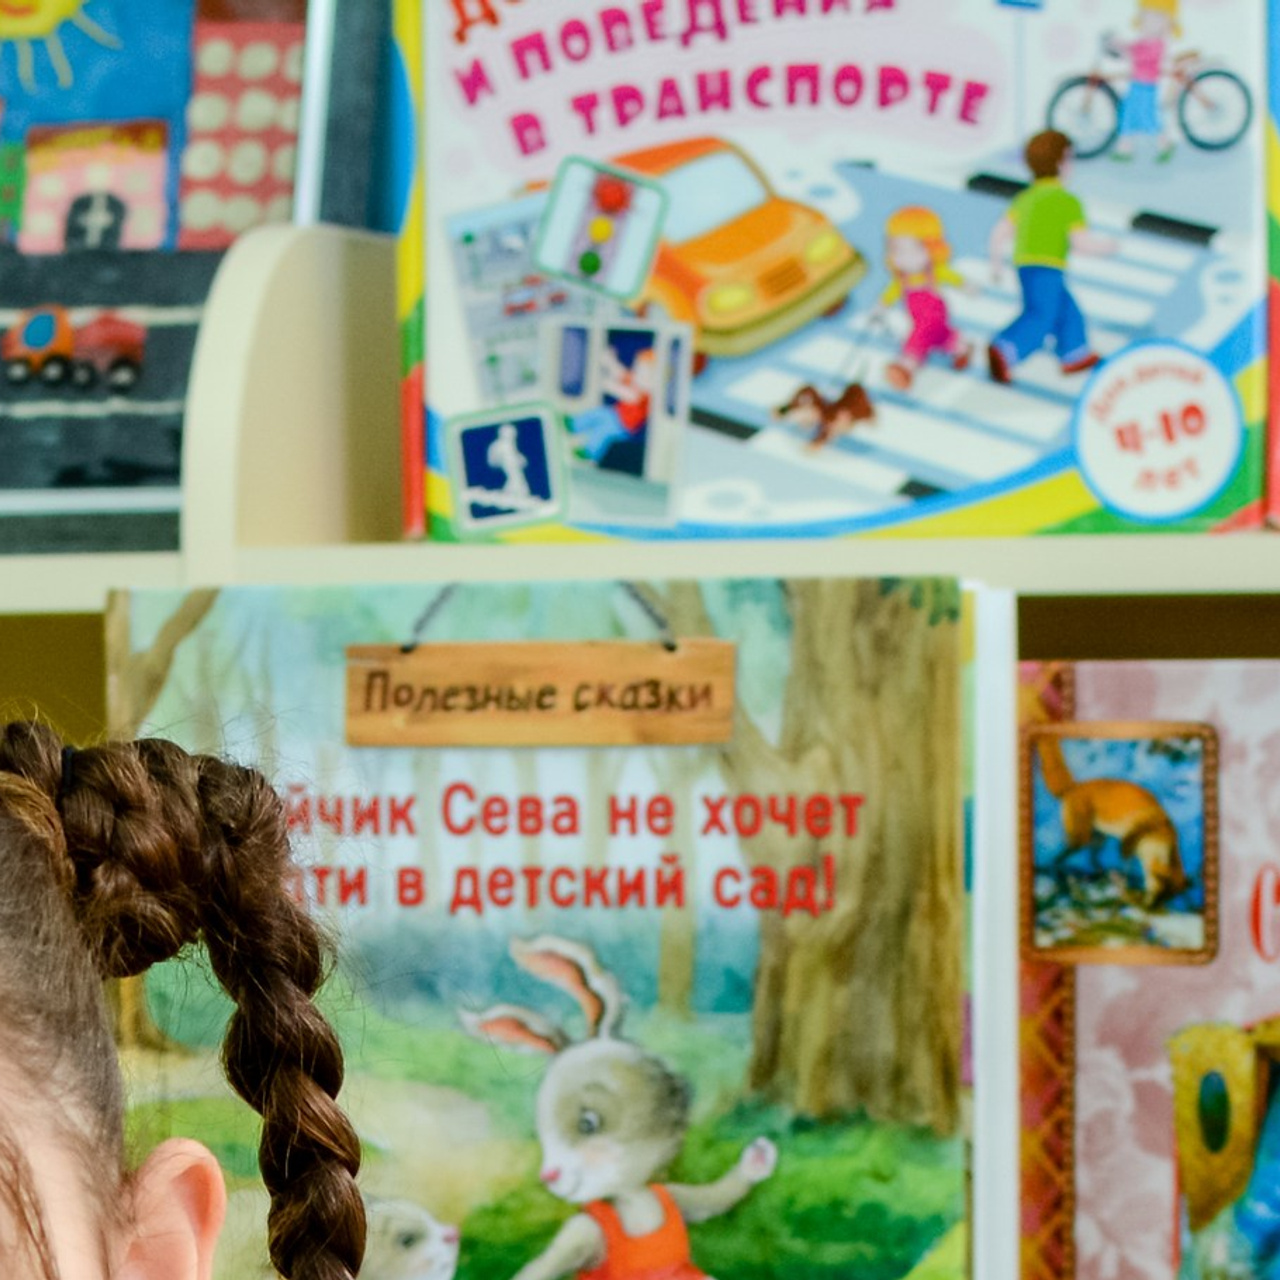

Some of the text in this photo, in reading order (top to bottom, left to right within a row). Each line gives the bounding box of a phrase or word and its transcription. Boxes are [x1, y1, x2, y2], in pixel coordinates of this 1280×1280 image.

[455, 57, 494, 106] И
[511, 64, 990, 156] В ТРАНСПОРТЕ
[363, 670, 714, 713] Полезные сказки
[441, 782, 580, 837] Сева
[608, 795, 676, 836] не
[701, 794, 866, 837] хочет
[397, 866, 426, 907] в
[450, 855, 687, 914] детский
[713, 854, 837, 917] сад!
